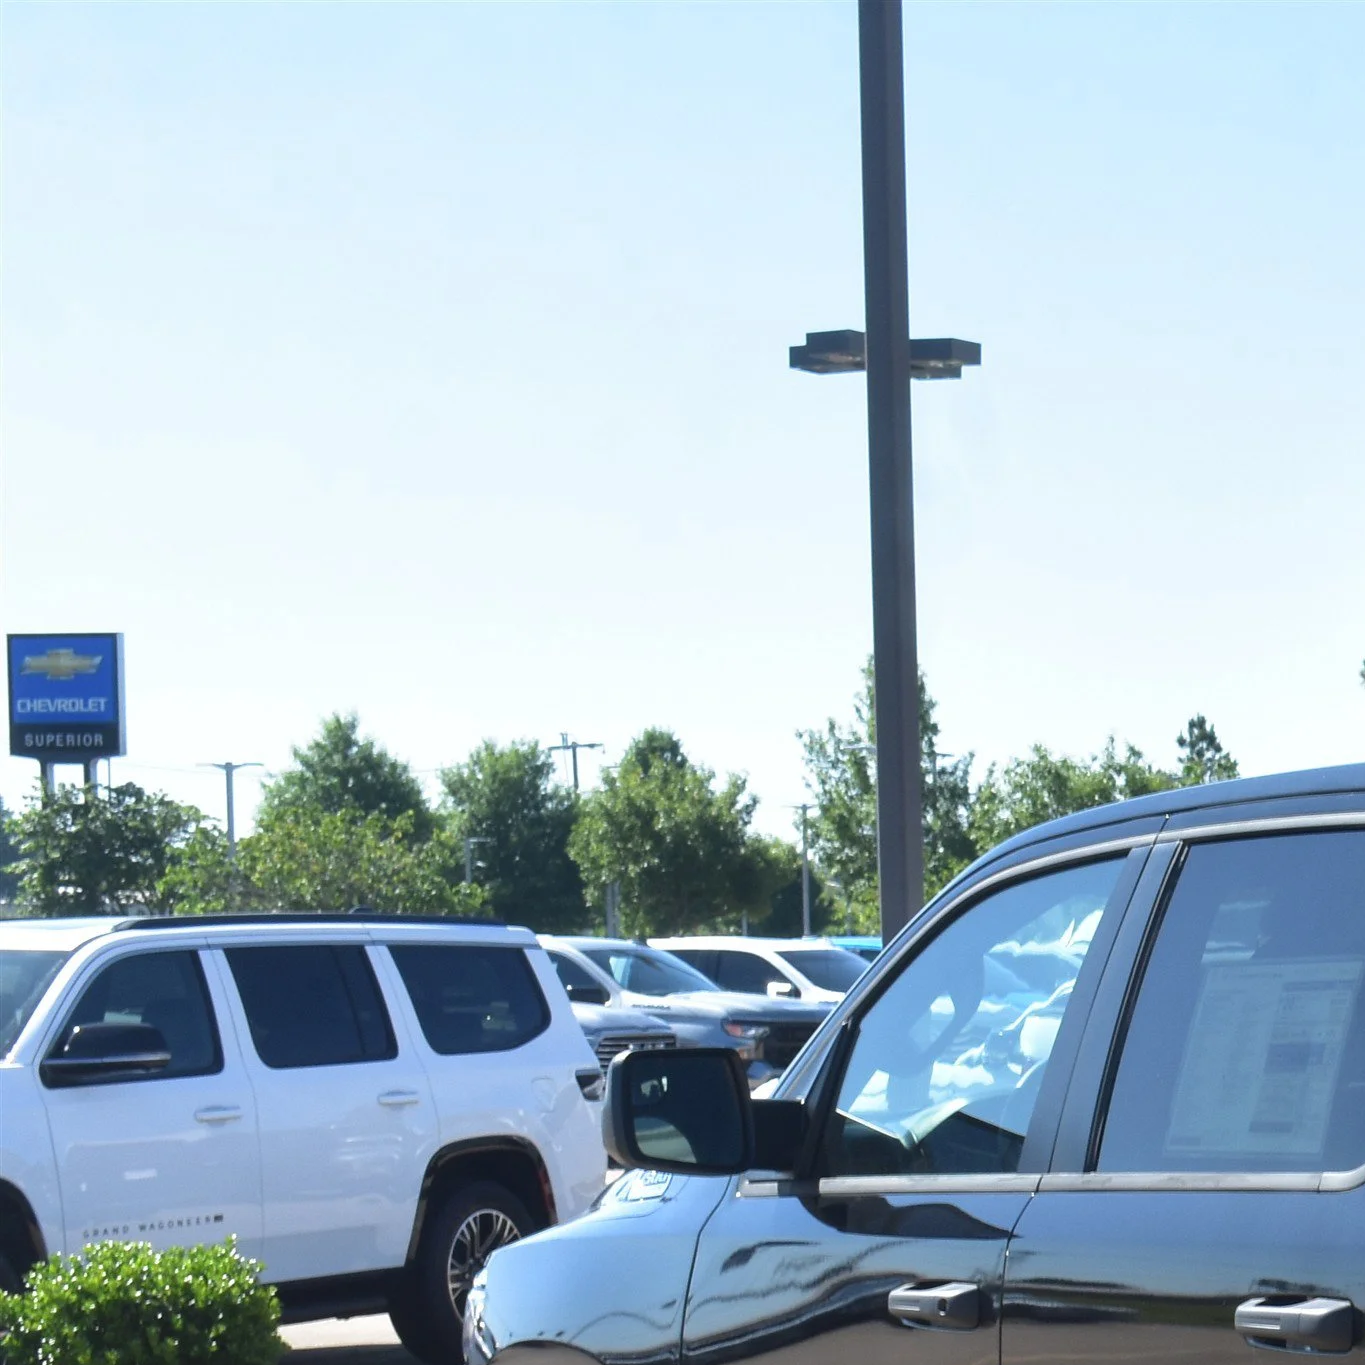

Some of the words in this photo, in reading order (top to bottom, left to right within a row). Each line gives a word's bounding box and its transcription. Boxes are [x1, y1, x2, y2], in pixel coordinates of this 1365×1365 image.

[16, 697, 108, 713] CHEVROLET
[24, 733, 104, 748] SUPERIOR
[83, 1224, 129, 1239] GRAND
